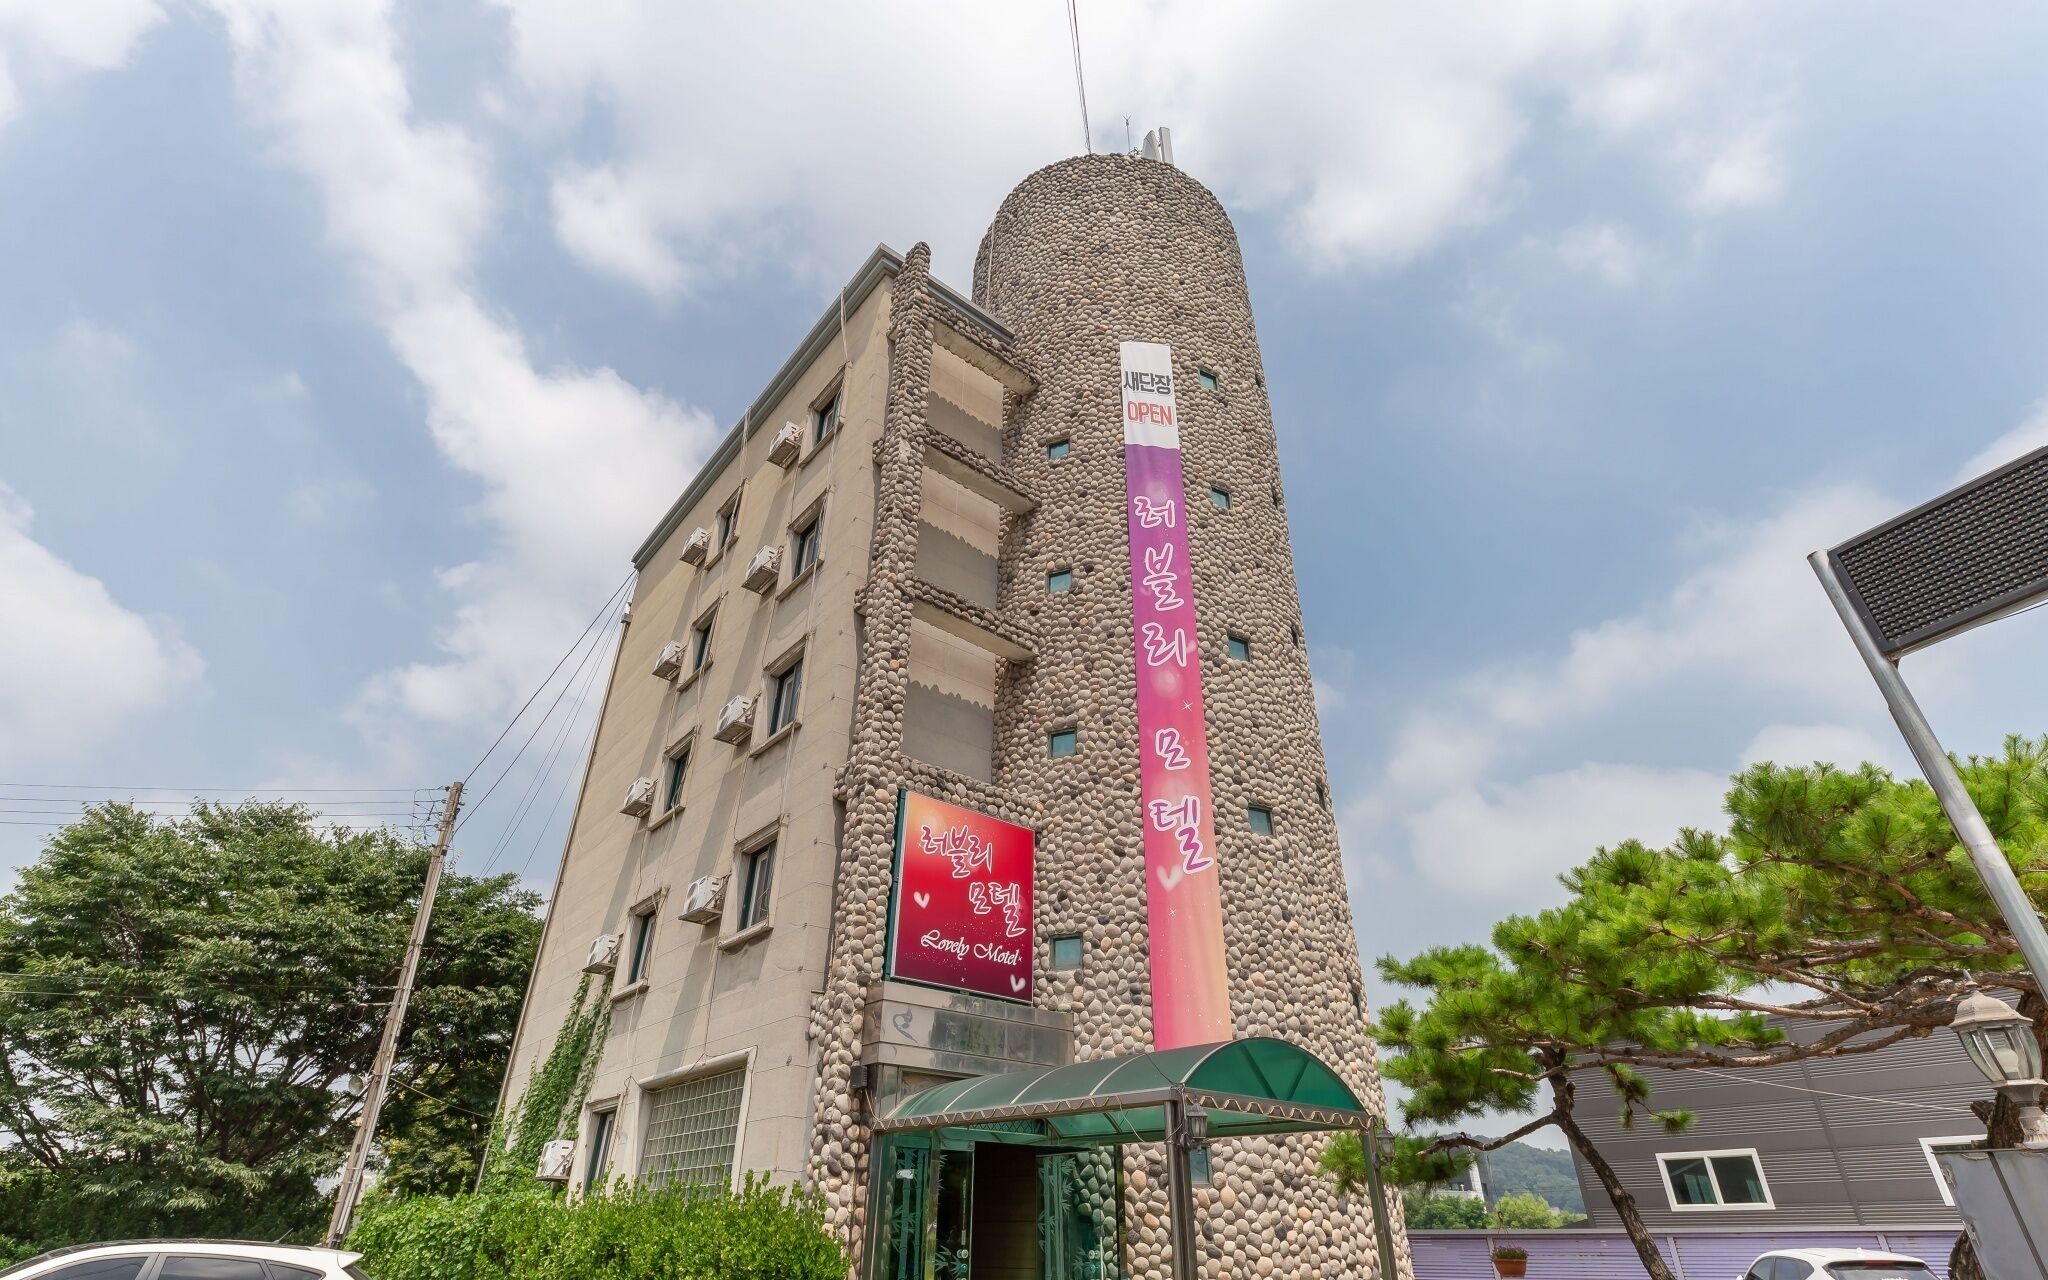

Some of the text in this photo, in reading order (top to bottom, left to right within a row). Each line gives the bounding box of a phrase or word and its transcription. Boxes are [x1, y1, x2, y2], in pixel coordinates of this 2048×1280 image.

[1123, 370, 1172, 395] 새단장
[1127, 400, 1174, 427] OPEN
[1133, 495, 1215, 875] 러블리 모텔
[921, 825, 993, 878] 러블리
[969, 881, 1027, 938] 모텔
[920, 929, 1020, 966] Lovely Motel
